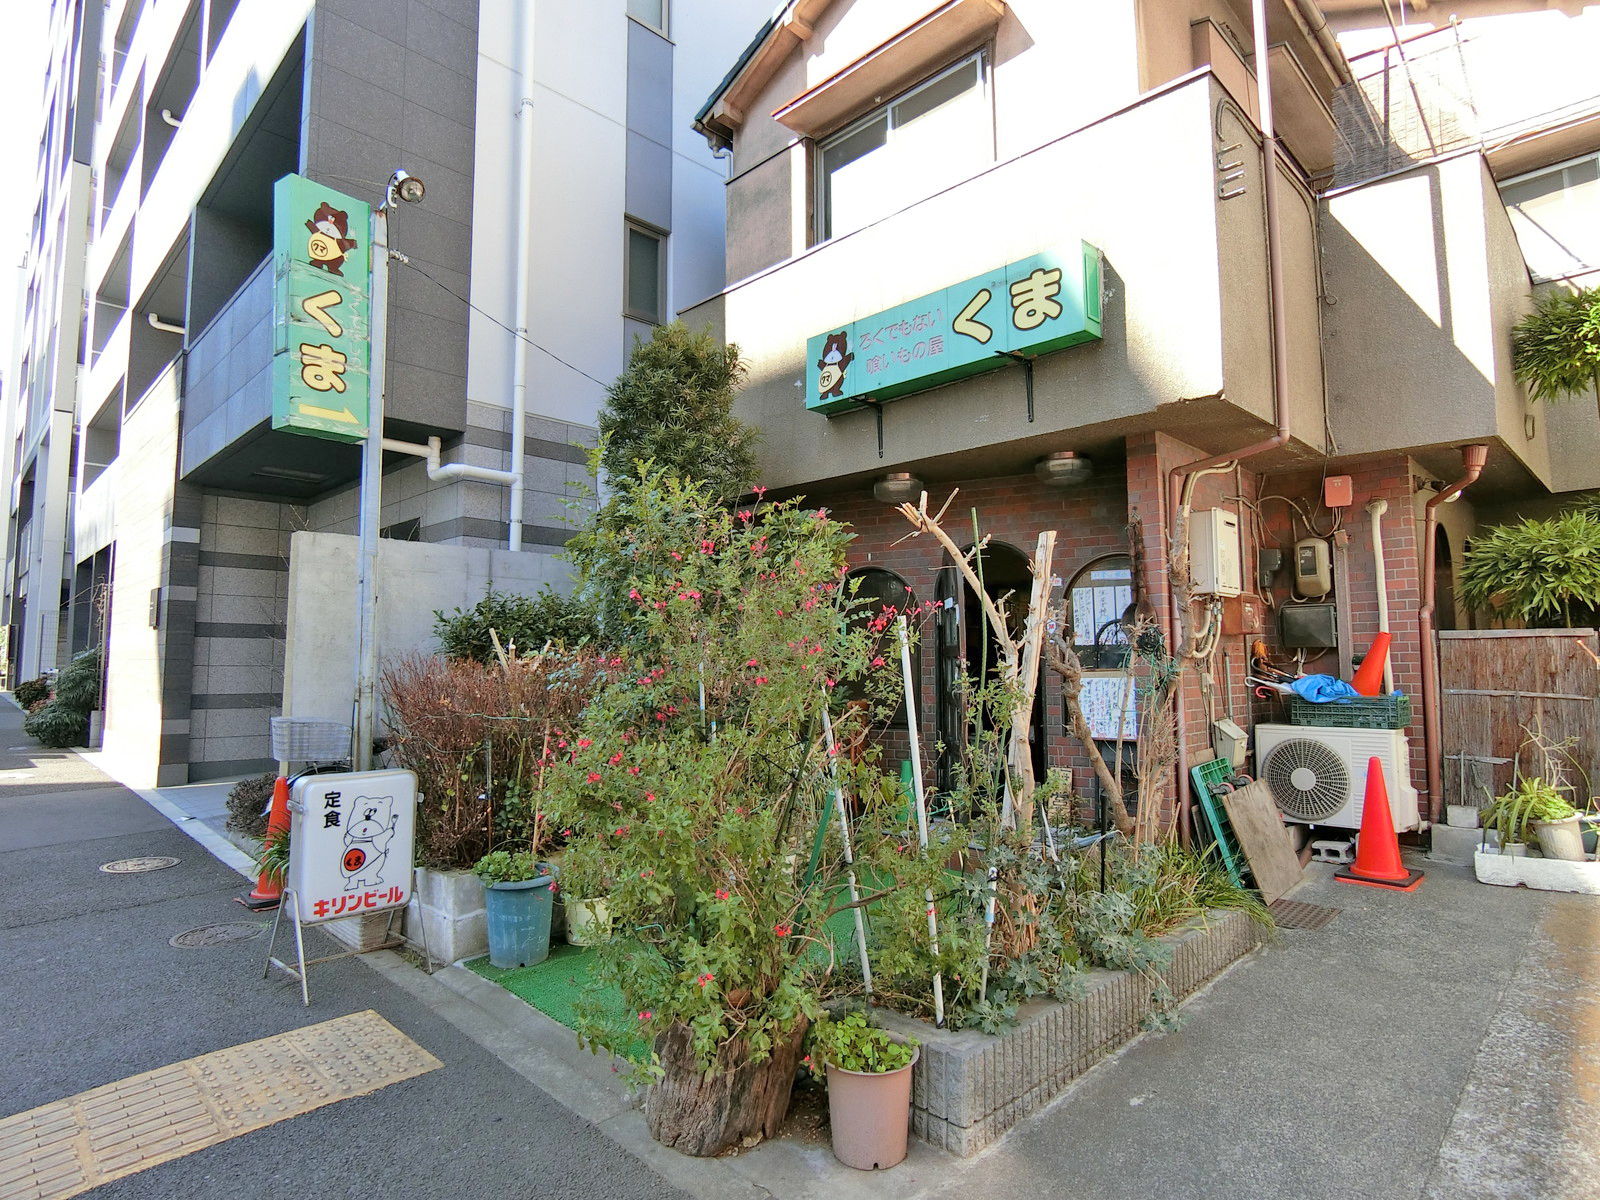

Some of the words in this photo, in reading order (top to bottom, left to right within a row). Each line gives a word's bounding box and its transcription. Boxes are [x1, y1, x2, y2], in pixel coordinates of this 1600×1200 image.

[313, 243, 328, 254] クマ
[953, 268, 1063, 344] くま
[300, 290, 347, 393] くま
[859, 308, 943, 351] ろくでもない
[866, 334, 944, 374] 喰いもの屋
[820, 373, 832, 386] クマ
[324, 791, 341, 829] 定食
[347, 856, 362, 867] くま
[314, 886, 404, 917] キリンビール
